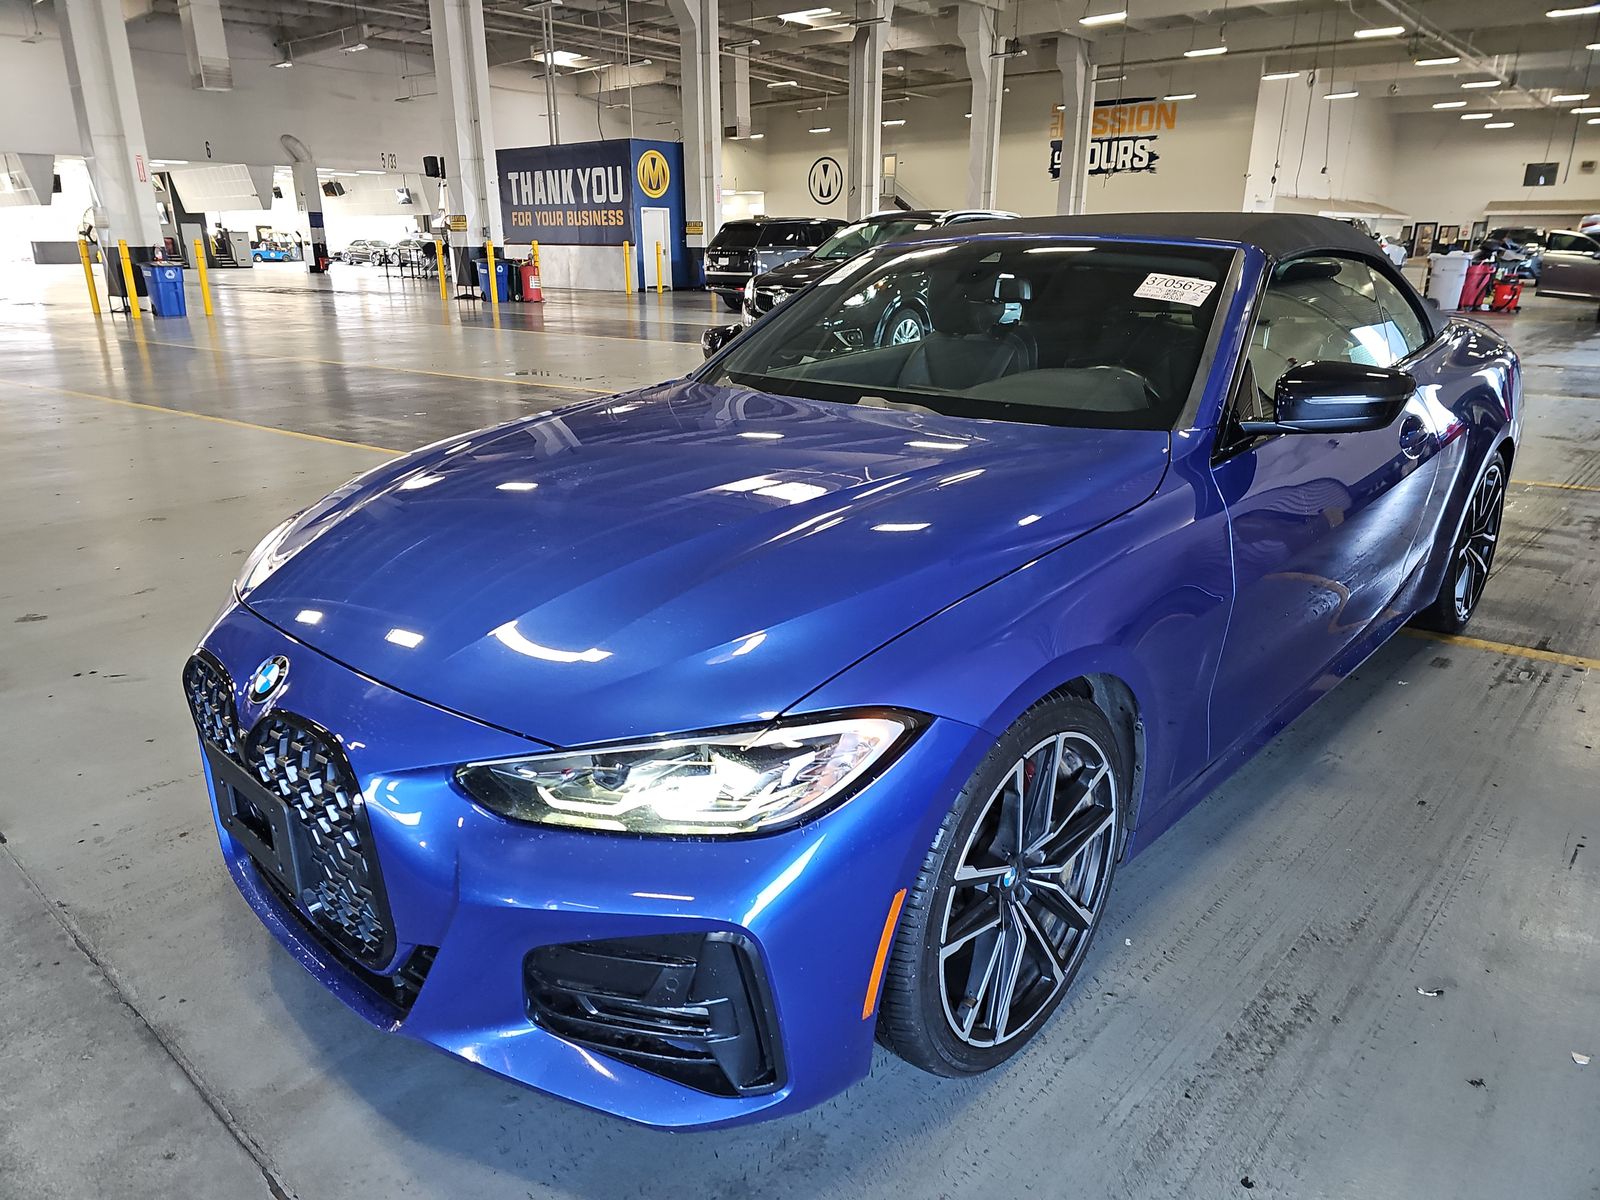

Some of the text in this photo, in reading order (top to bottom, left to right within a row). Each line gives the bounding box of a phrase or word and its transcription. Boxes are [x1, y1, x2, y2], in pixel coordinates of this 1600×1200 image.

[1091, 102, 1178, 136] SSION
[205, 141, 211, 158] 6
[1088, 139, 1151, 170] OURS
[507, 165, 623, 206] THANK YOU
[511, 209, 624, 227] FOR YOUR BUSINESS
[1145, 276, 1213, 295] 3705672
